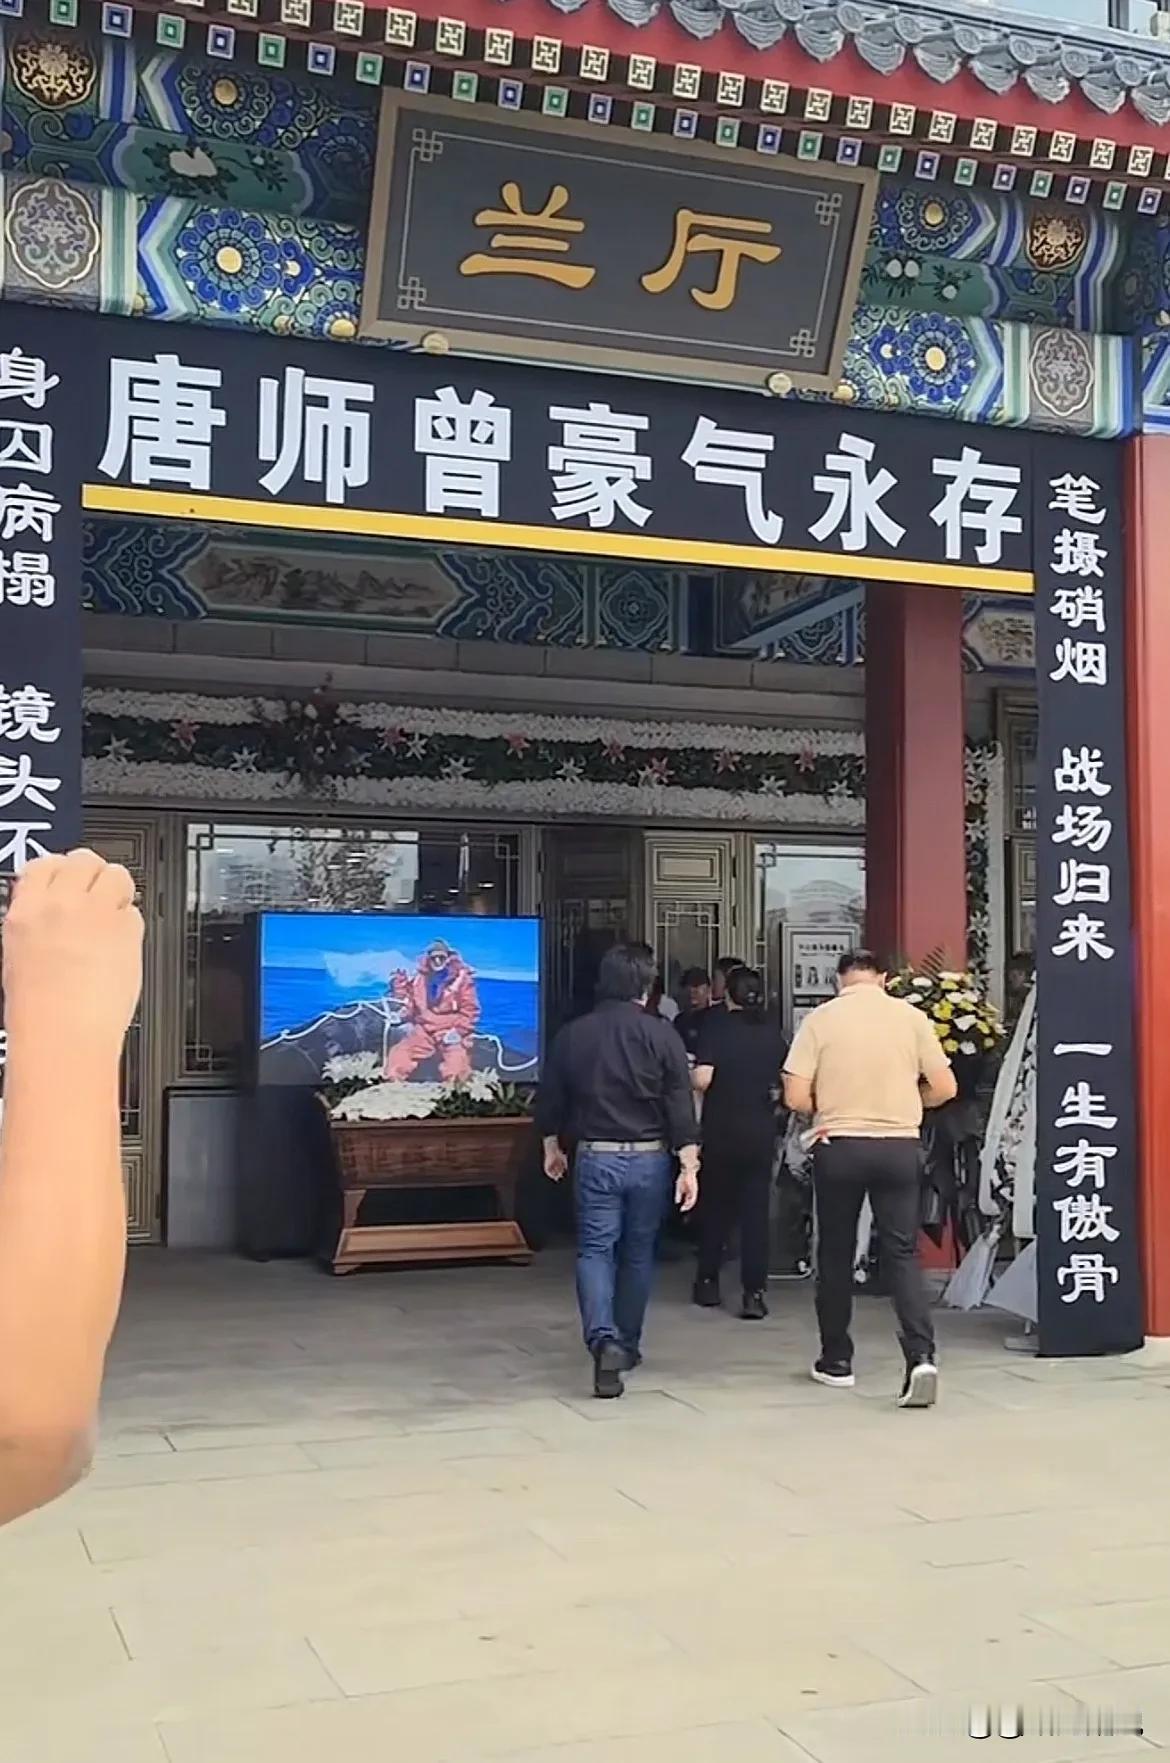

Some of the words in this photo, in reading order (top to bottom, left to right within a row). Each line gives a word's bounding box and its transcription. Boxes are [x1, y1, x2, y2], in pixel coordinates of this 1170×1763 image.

[460, 182, 782, 310] 兰厅
[98, 354, 1023, 565] 唐师曾豪气永存
[1048, 472, 1107, 686] 笔摄硝烟
[1051, 747, 1115, 961] 战场归来
[1052, 1042, 1120, 1303] 一生有傲骨
